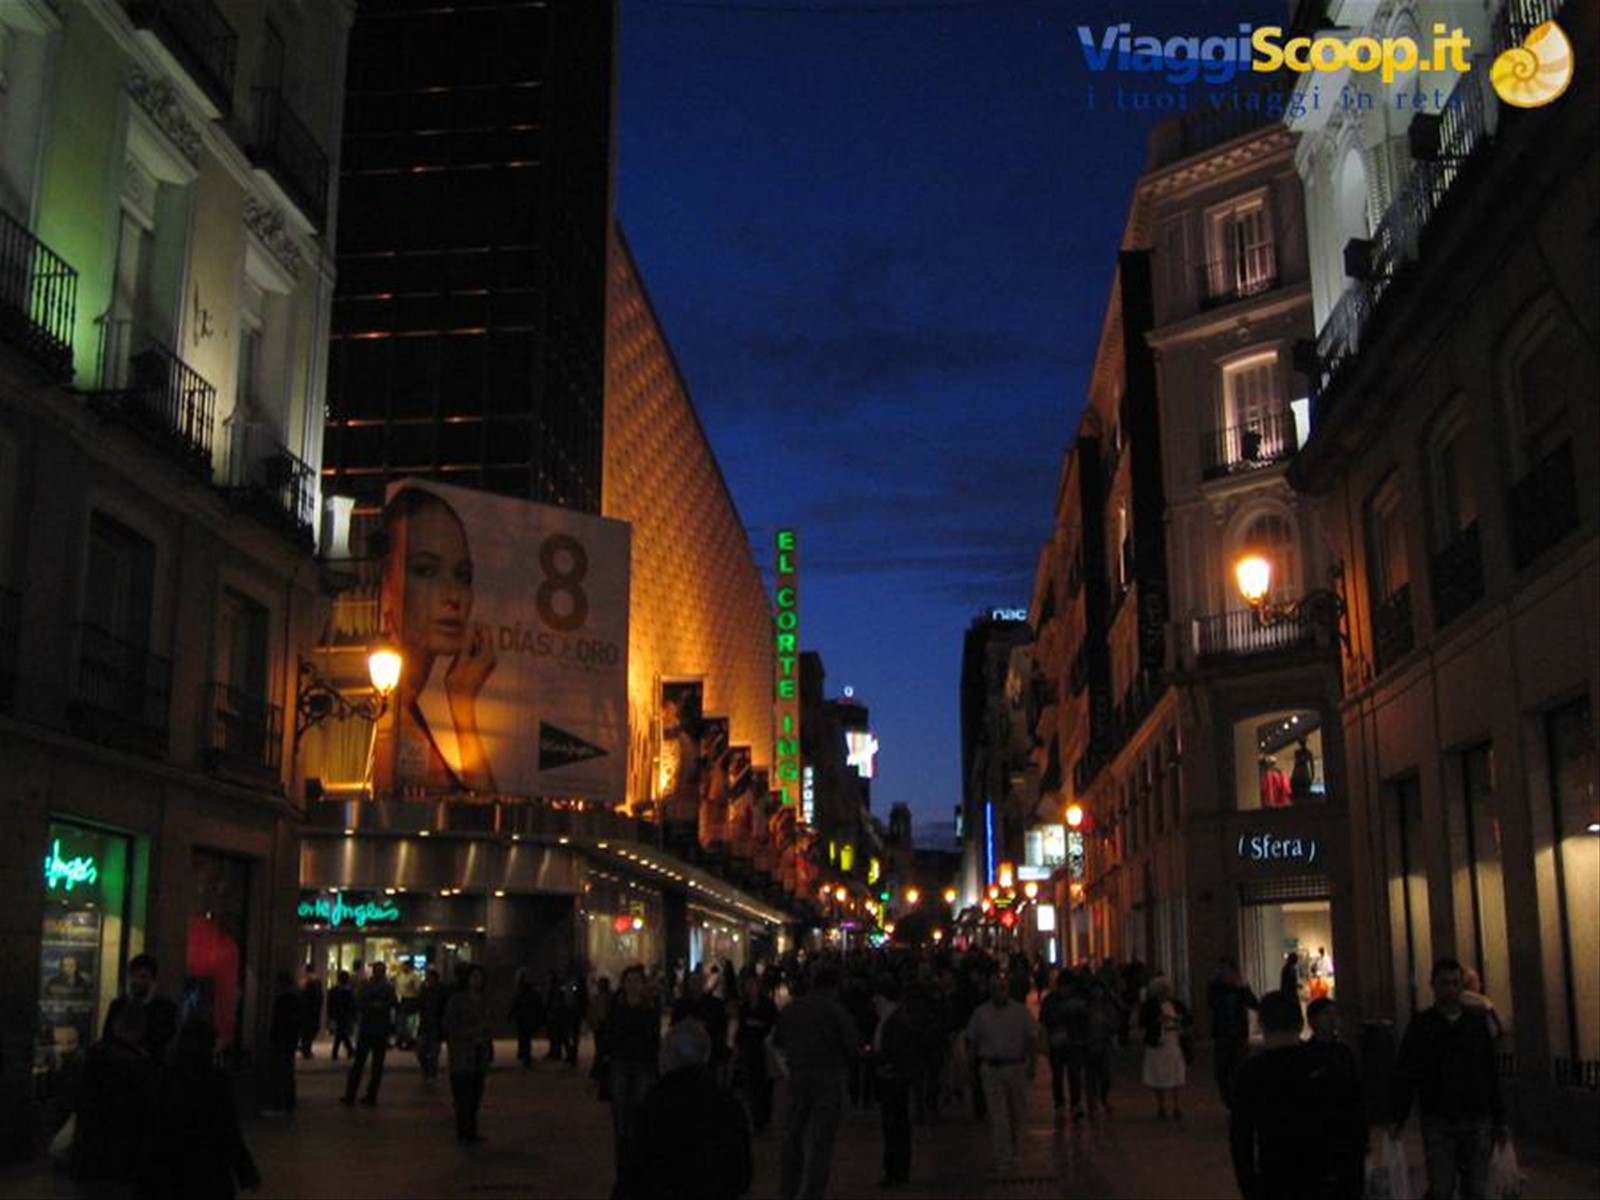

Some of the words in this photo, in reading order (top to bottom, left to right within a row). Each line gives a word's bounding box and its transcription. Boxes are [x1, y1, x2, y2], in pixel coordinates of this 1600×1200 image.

[537, 533, 588, 632] 8
[778, 532, 794, 572] EL
[777, 588, 798, 697] CORTE
